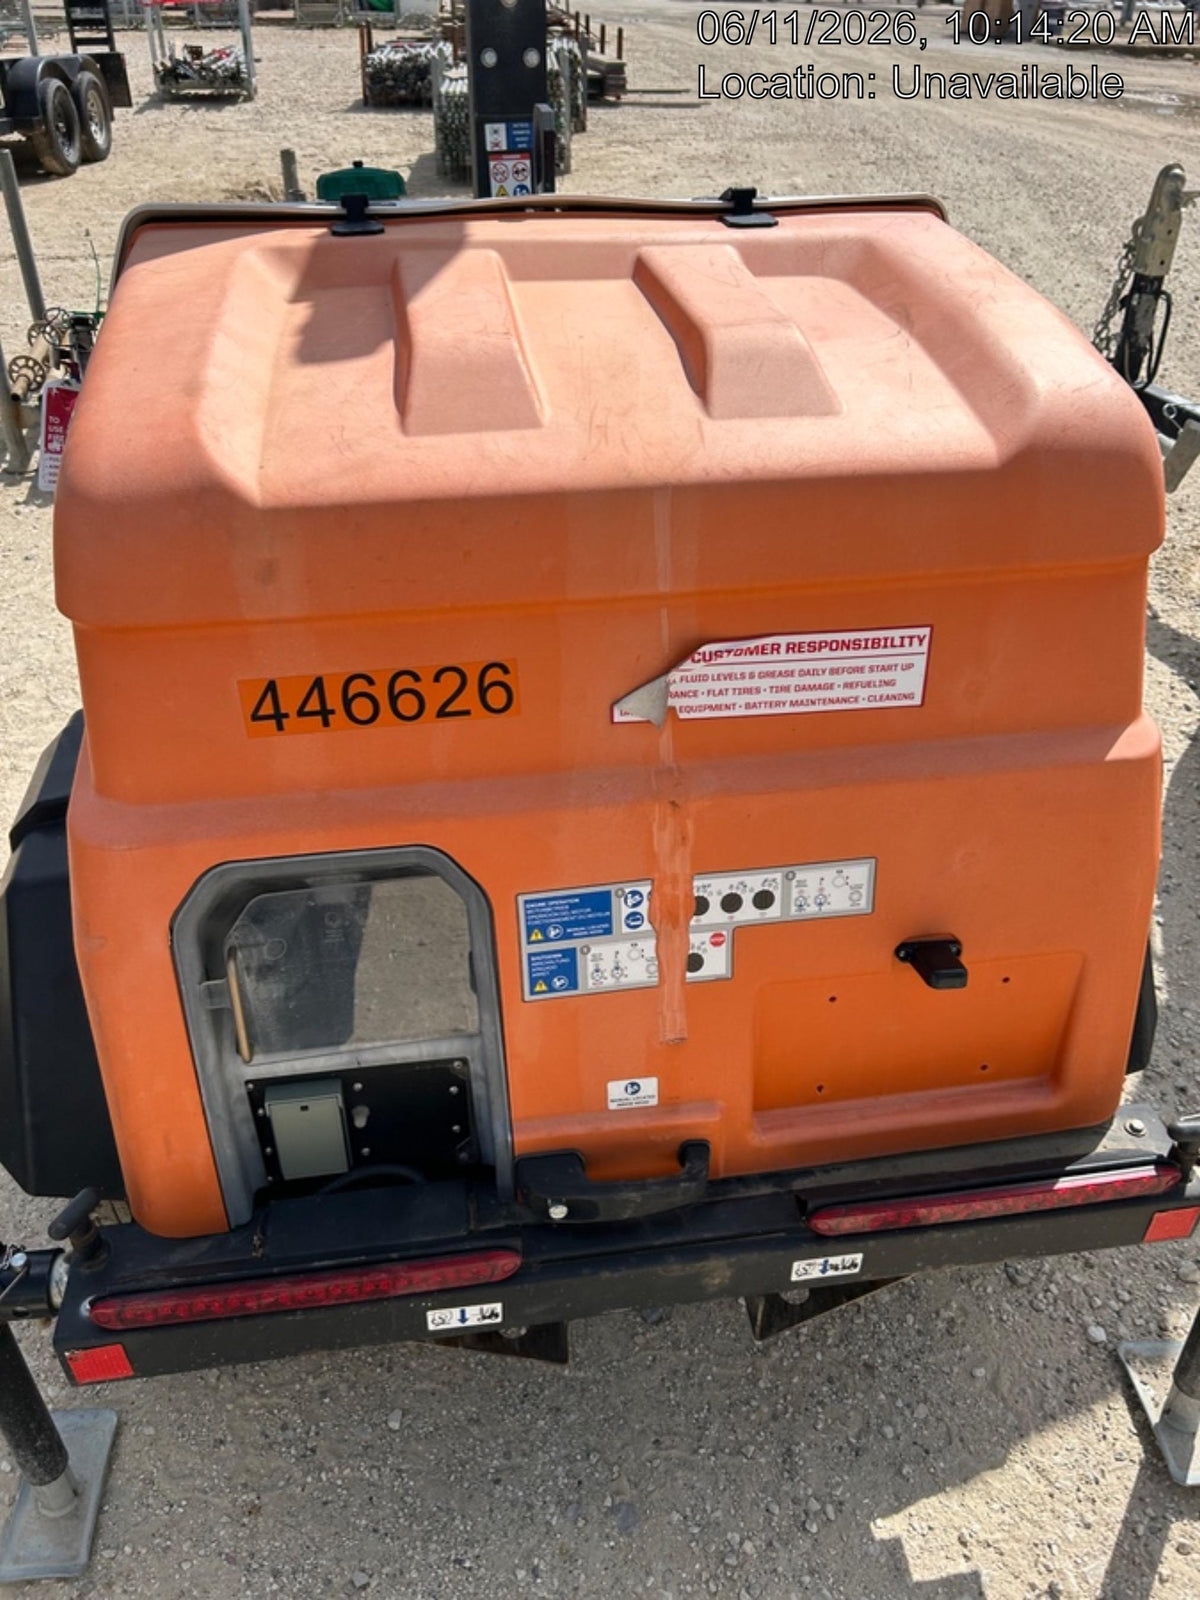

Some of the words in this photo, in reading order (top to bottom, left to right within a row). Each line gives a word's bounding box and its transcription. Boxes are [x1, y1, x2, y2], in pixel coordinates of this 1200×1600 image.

[785, 634, 927, 654] RESPONSIBILITY
[680, 672, 710, 684] FLUID
[711, 671, 746, 682] LEVELS
[757, 668, 796, 680] GREASE
[798, 667, 827, 678] DAILY
[828, 665, 866, 676] BEFORE
[867, 663, 898, 674] START
[900, 662, 915, 672] UP
[250, 661, 515, 732] 446626
[707, 688, 728, 698] FLAT
[732, 686, 761, 697] TIRES
[769, 685, 791, 695] TIRE
[794, 682, 835, 693] DAMAGE
[842, 679, 897, 690] REFUELING
[678, 703, 736, 715] EQUIPMENT
[744, 699, 787, 710] BATTERY
[789, 695, 860, 708] MAINTENANCE
[867, 692, 915, 704] CLEANING
